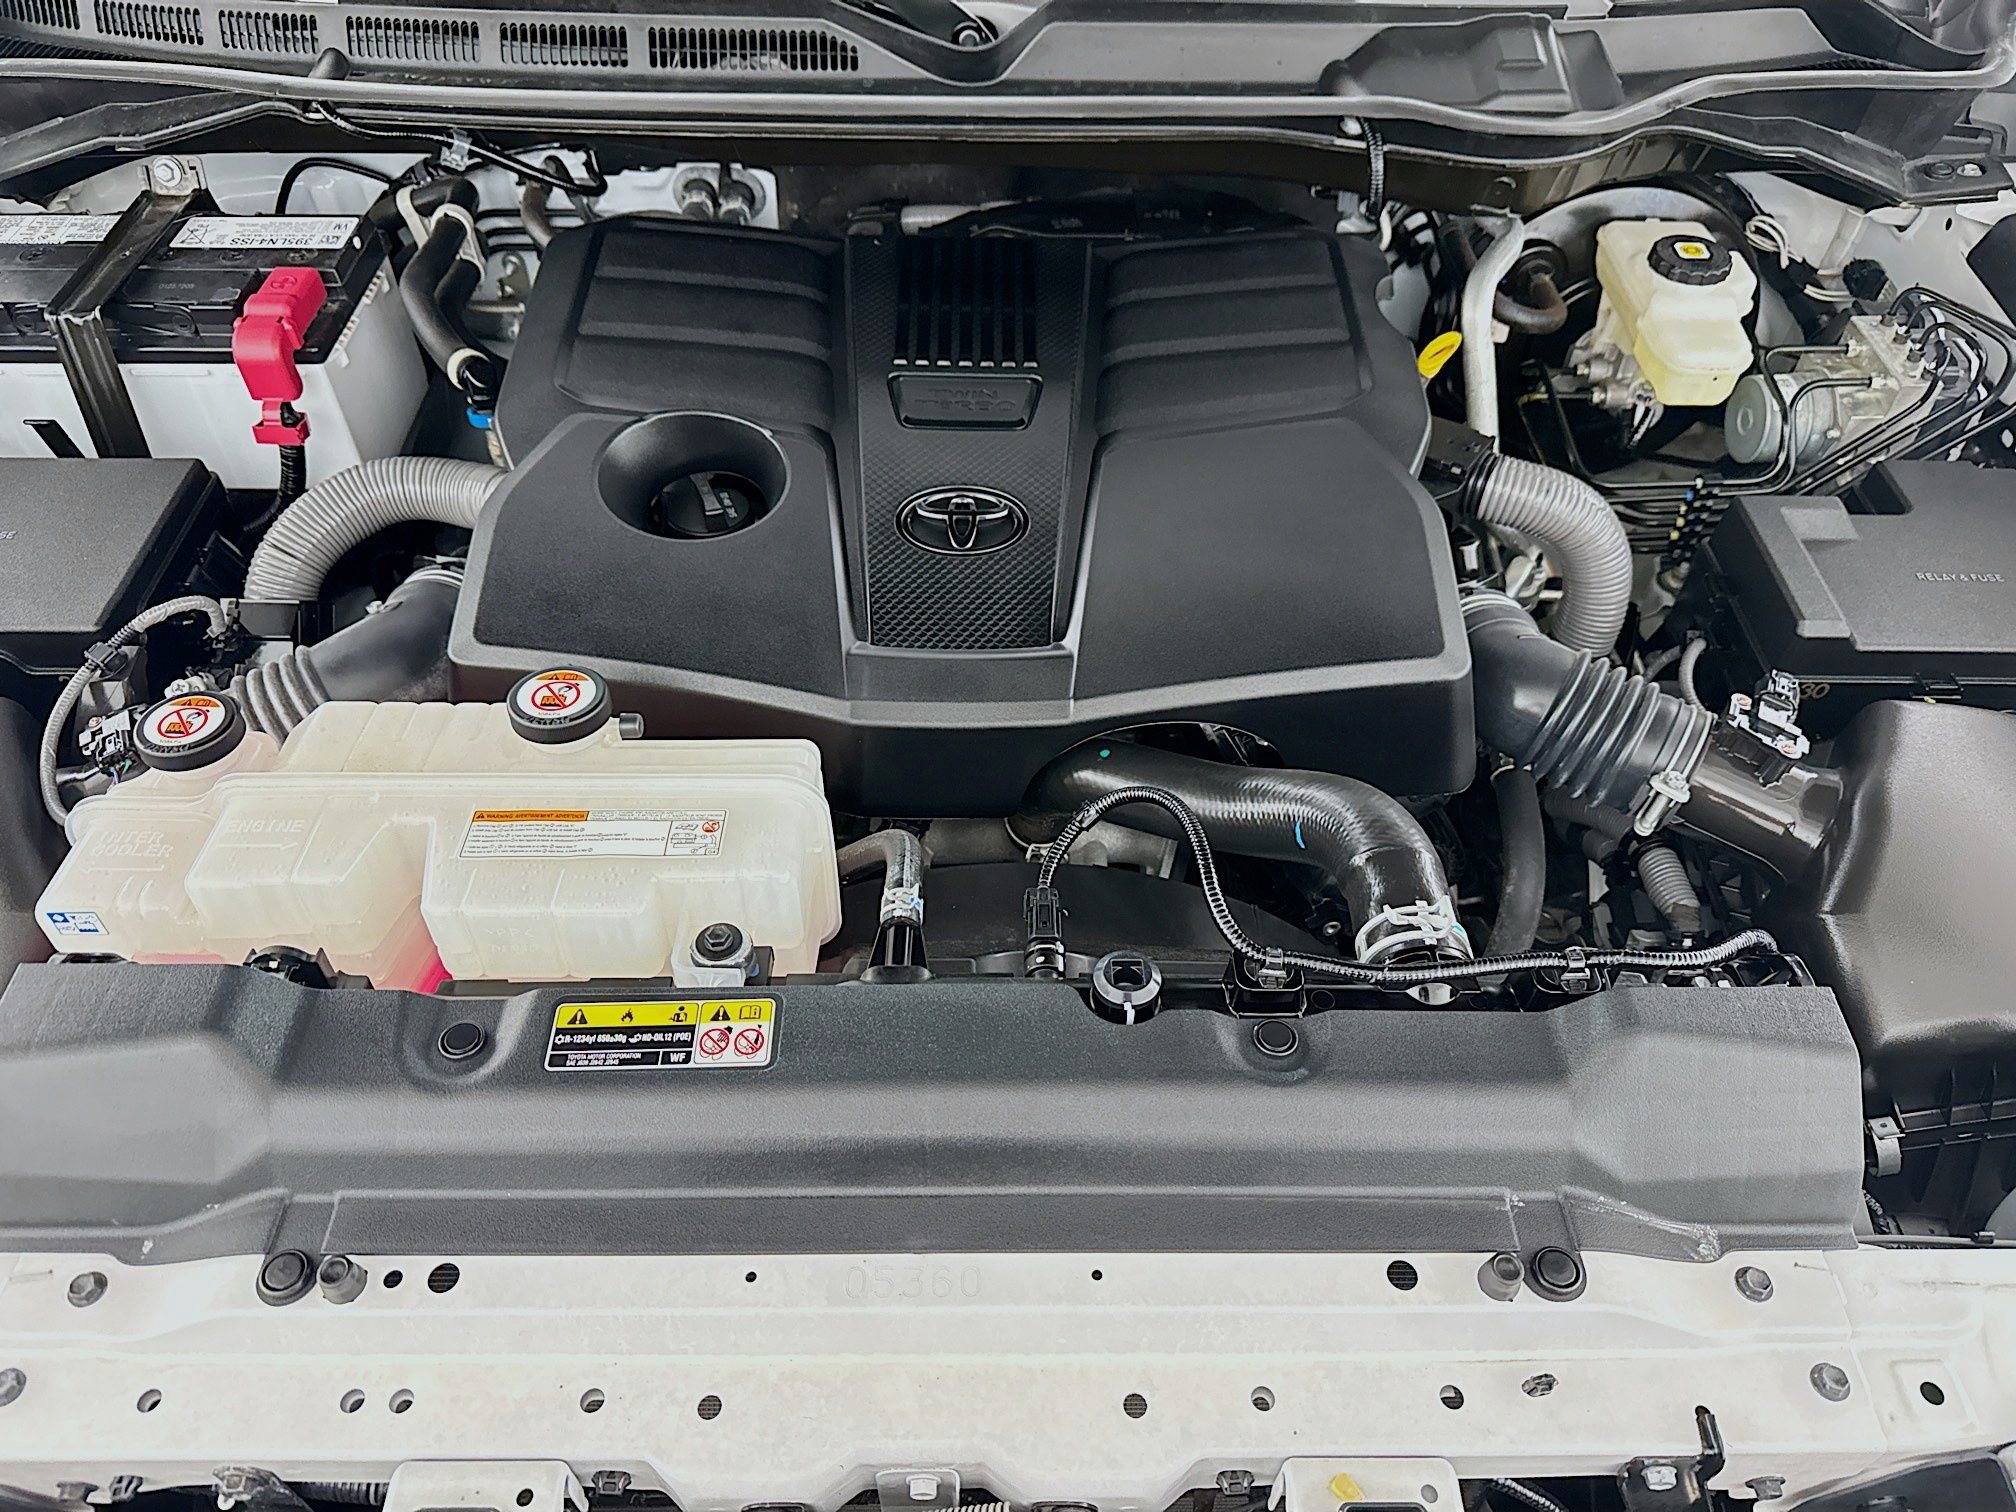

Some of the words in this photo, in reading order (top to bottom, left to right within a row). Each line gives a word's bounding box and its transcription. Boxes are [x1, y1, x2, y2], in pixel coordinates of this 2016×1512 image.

[229, 236, 314, 246] 395LN4-ISS
[1915, 572, 1956, 582] RELAY
[1970, 573, 2005, 582] FUSE
[224, 819, 305, 832] ENGINE
[100, 831, 164, 843] INTER
[91, 843, 174, 857] COOLER
[564, 1034, 597, 1045] R-1234yf
[673, 1032, 691, 1043] (POE)
[606, 1052, 642, 1060] CORPORATION
[670, 1052, 687, 1063] WF
[846, 1265, 982, 1298] 05360
